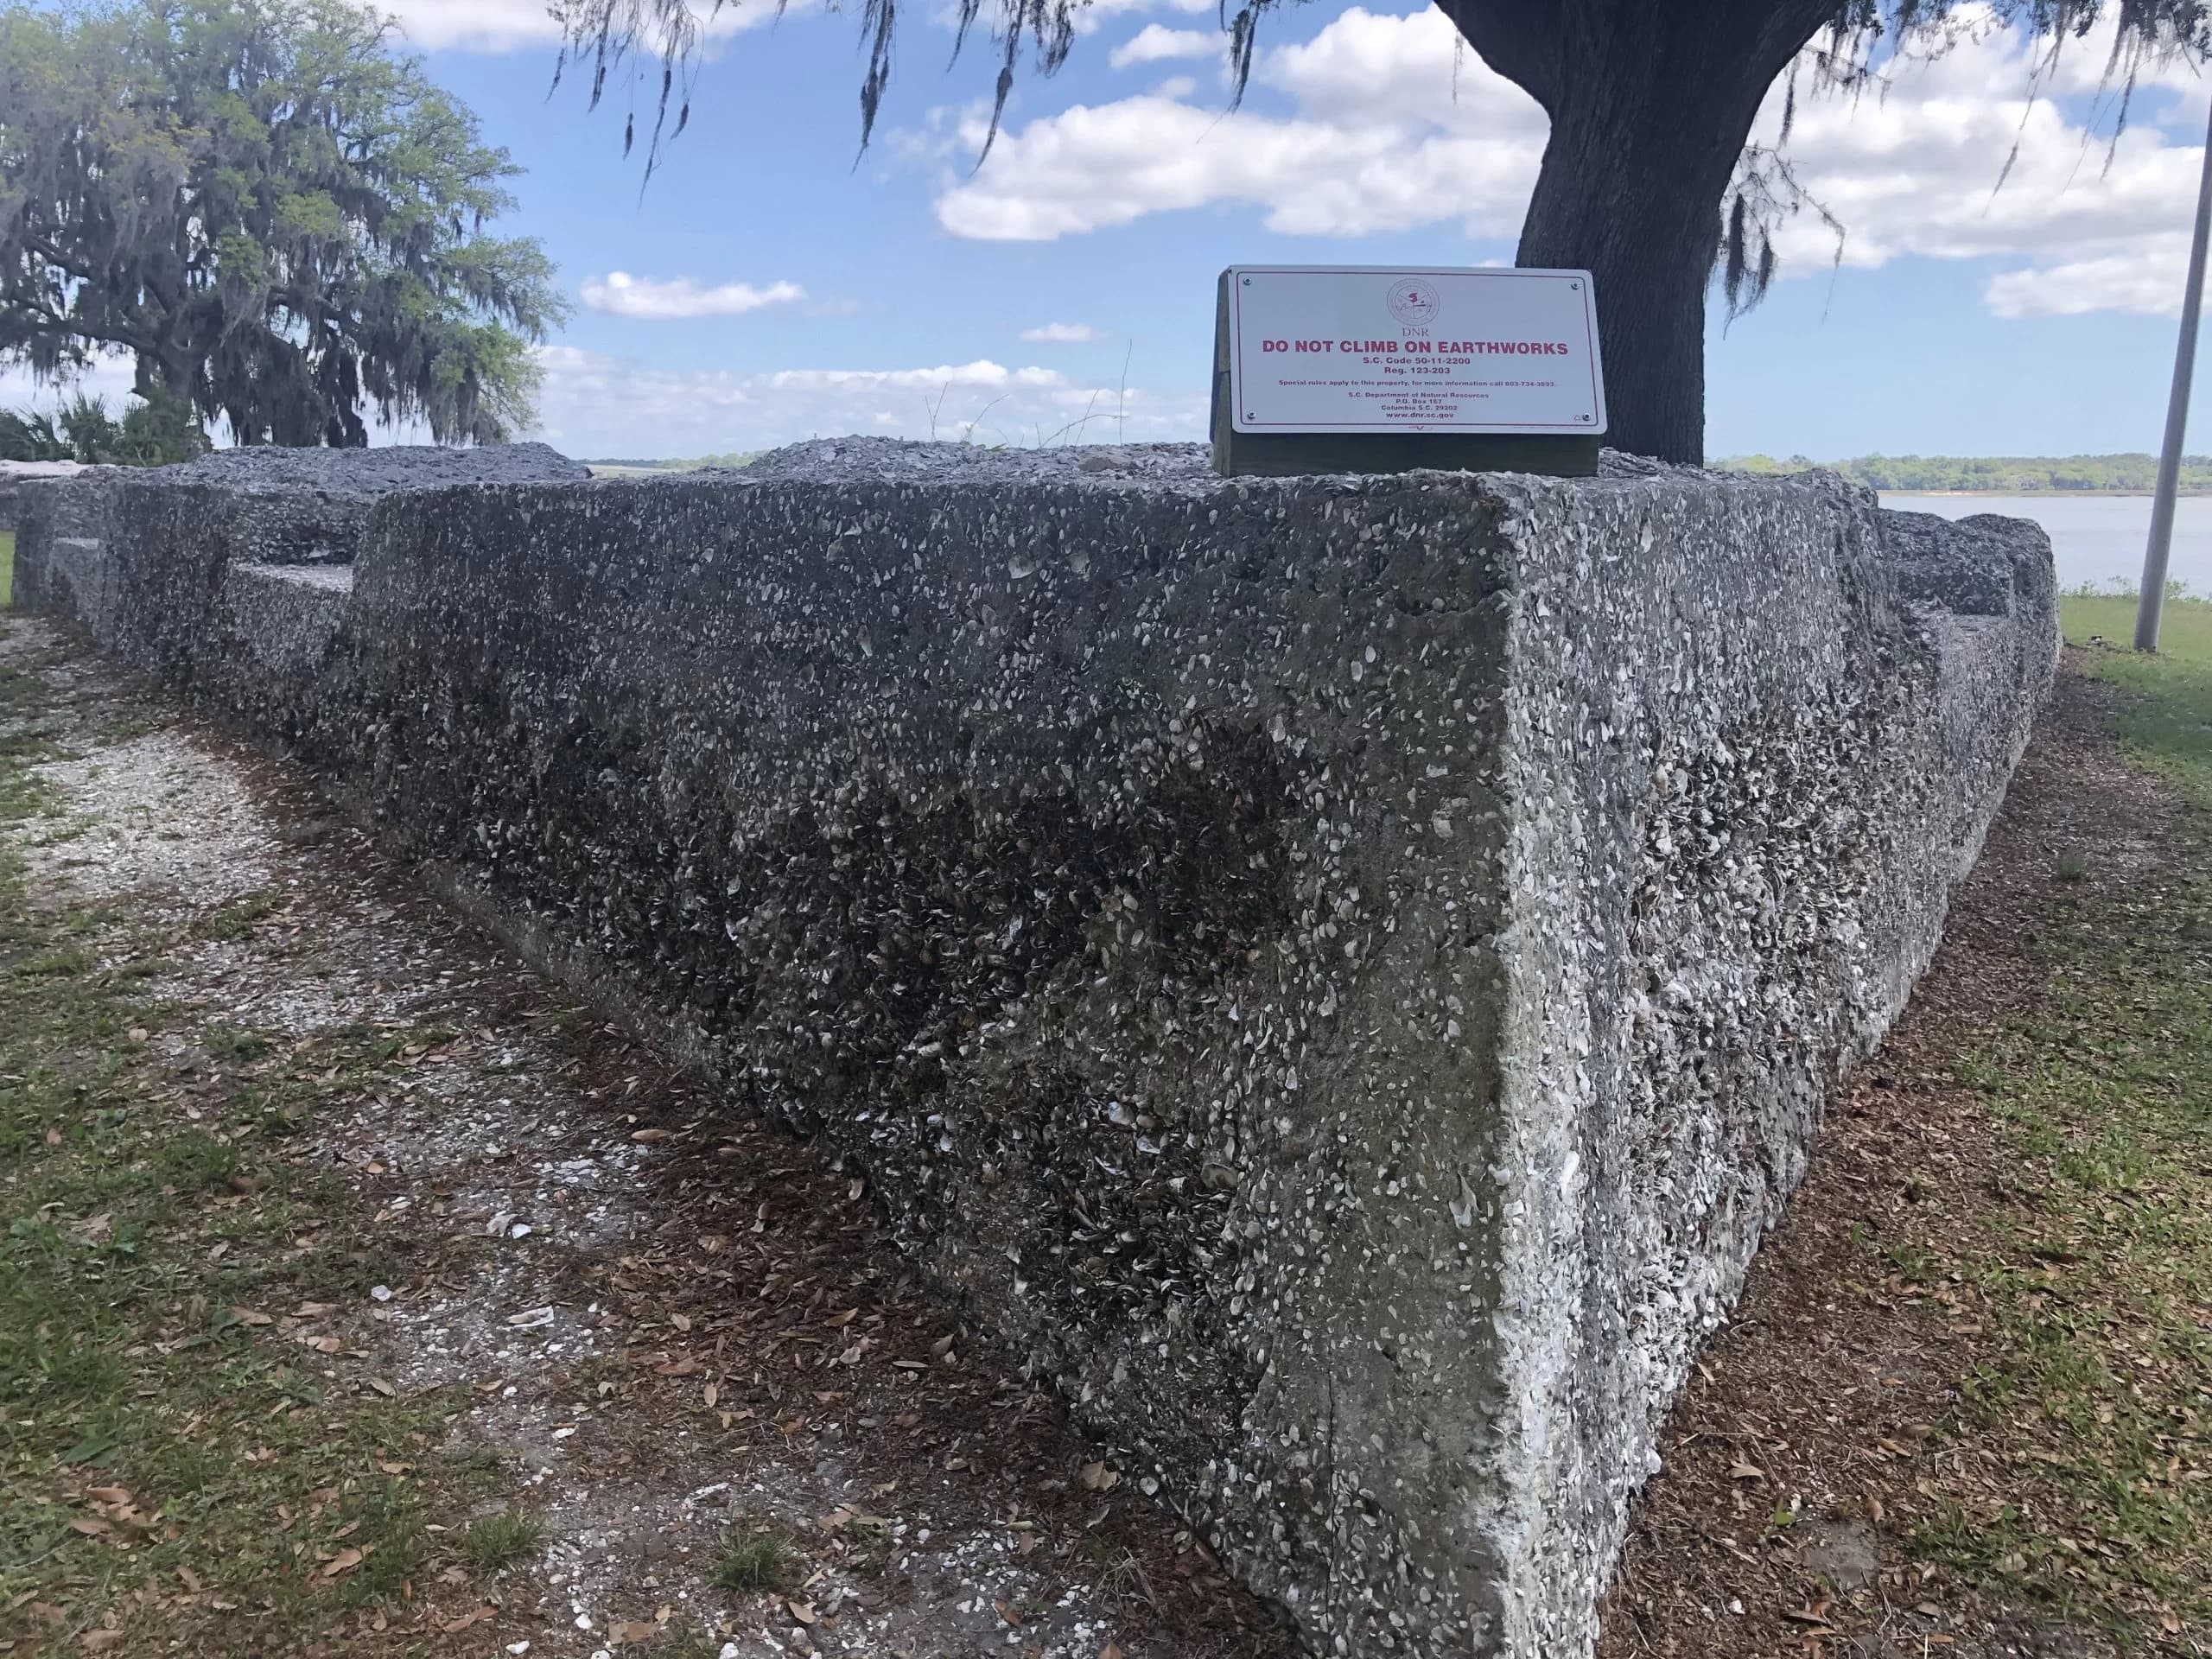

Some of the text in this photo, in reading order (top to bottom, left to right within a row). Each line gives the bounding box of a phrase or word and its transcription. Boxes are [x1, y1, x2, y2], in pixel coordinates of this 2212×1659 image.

[1402, 327, 1429, 337] DNR
[1262, 340, 1568, 355] DO NOT CLIMB ON EARTHWORKS
[1384, 366, 1451, 376] Reg. 123-203
[1386, 410, 1454, 419] www.dnr.sc.gov
